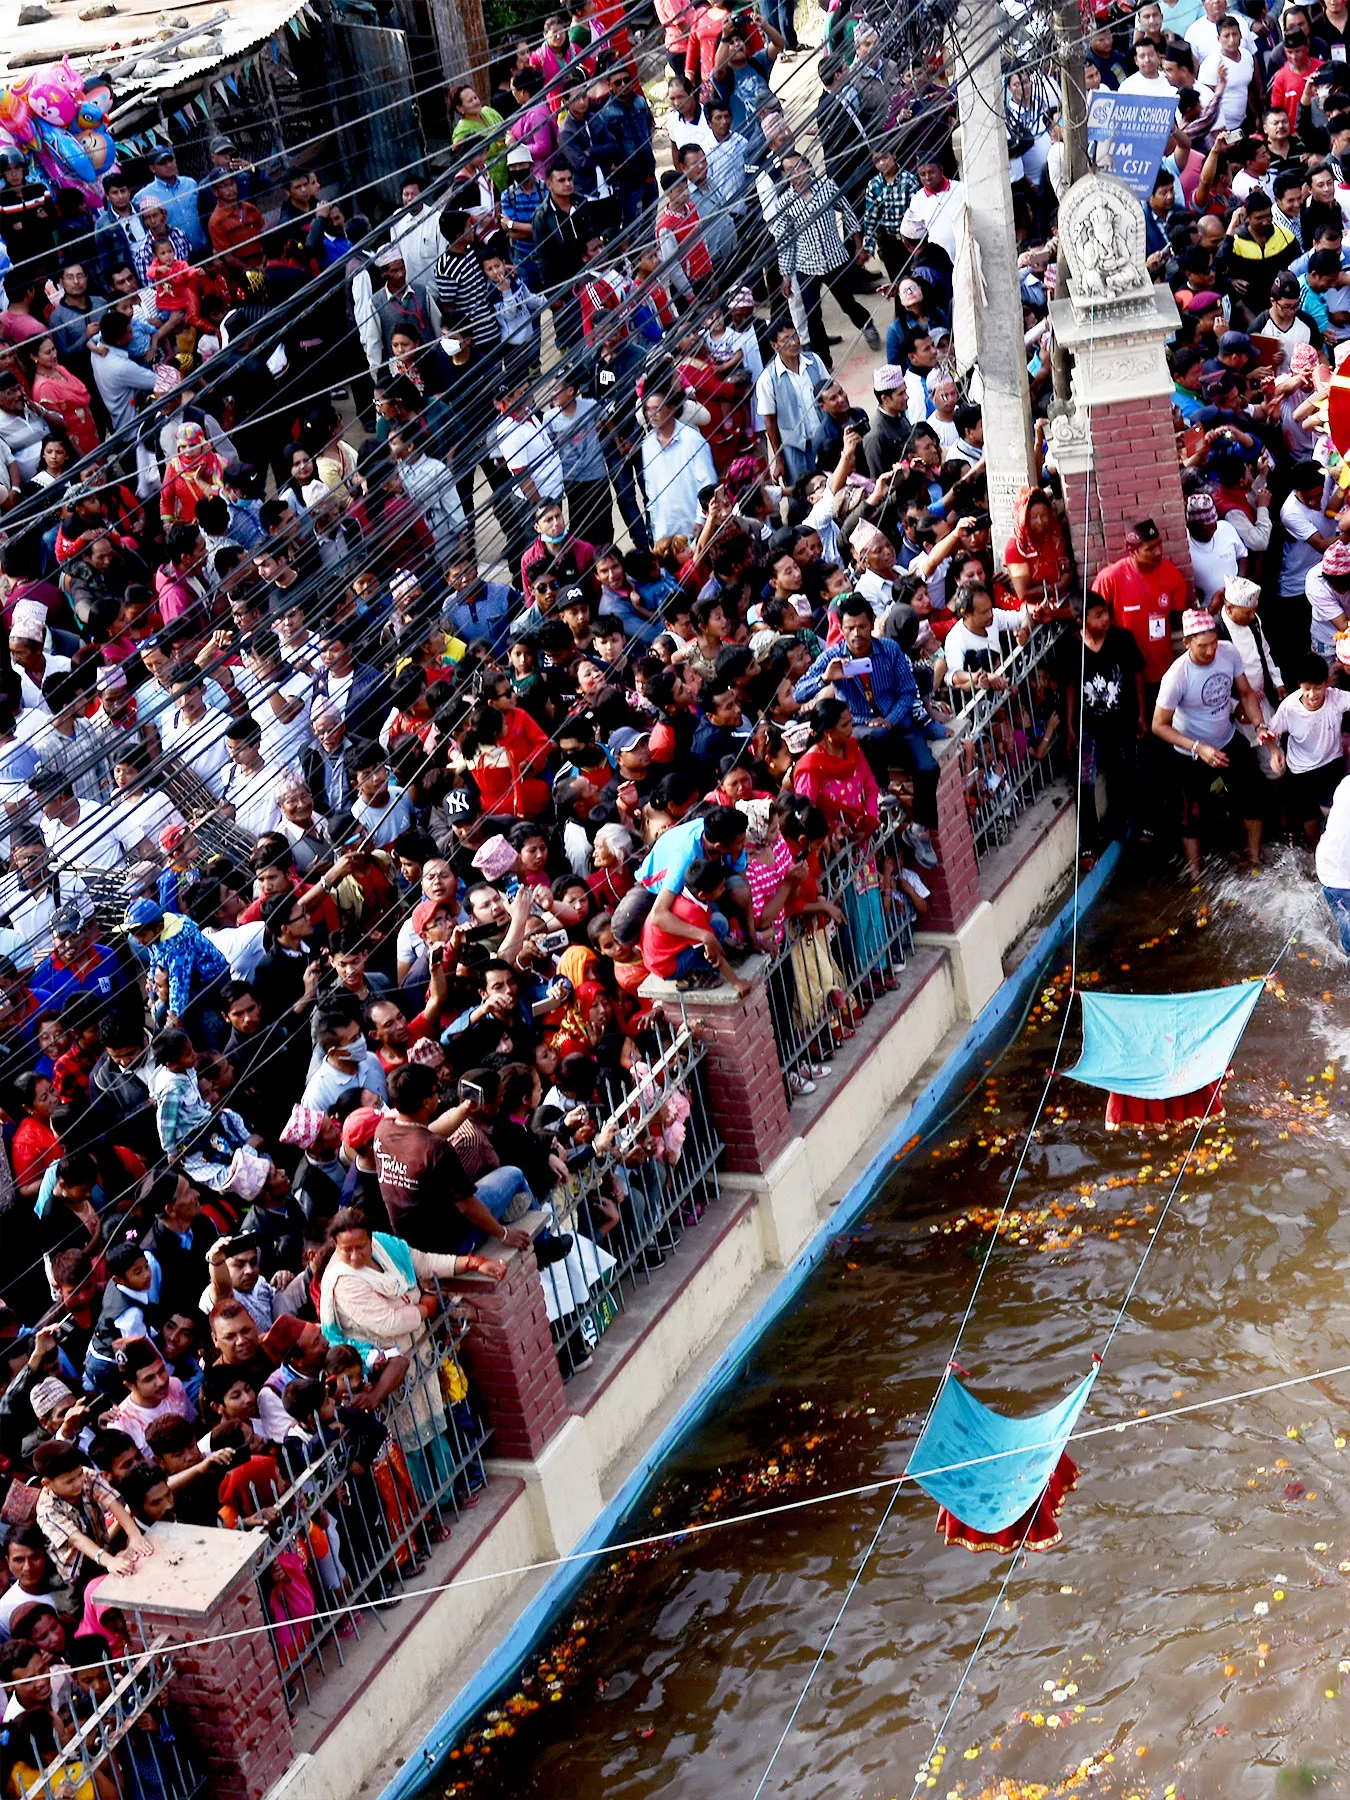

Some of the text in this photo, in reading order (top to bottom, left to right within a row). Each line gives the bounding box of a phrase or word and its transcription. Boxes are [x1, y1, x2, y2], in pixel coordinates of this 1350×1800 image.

[1111, 105, 1171, 125] ASIAN SCHOOL
[1121, 123, 1169, 134] MANAGEMENT
[1122, 160, 1152, 175] CSIT
[446, 791, 470, 815] NY
